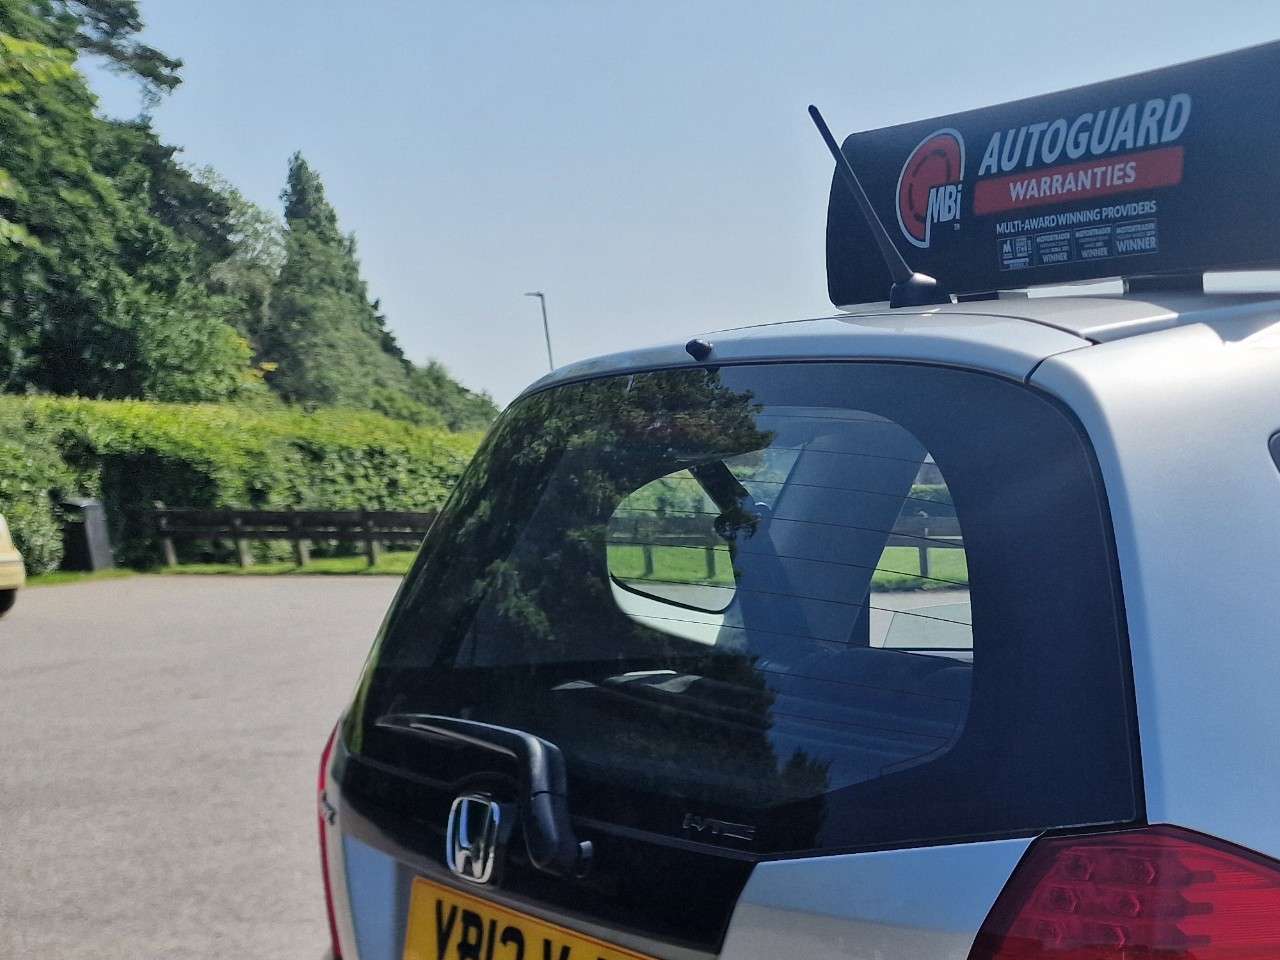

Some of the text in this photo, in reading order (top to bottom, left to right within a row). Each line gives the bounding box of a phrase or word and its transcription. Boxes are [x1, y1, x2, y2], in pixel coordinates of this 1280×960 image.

[978, 93, 1192, 176] AUTOGUARD
[1009, 162, 1137, 201] WARRANTIES
[996, 215, 1057, 234] MULTI-AWARD
[1058, 209, 1100, 226] WINNING
[1102, 200, 1157, 219] PROVIDERS
[1081, 247, 1109, 258] WINNER
[1117, 236, 1157, 253] WINNER
[1042, 252, 1068, 264] WINNER
